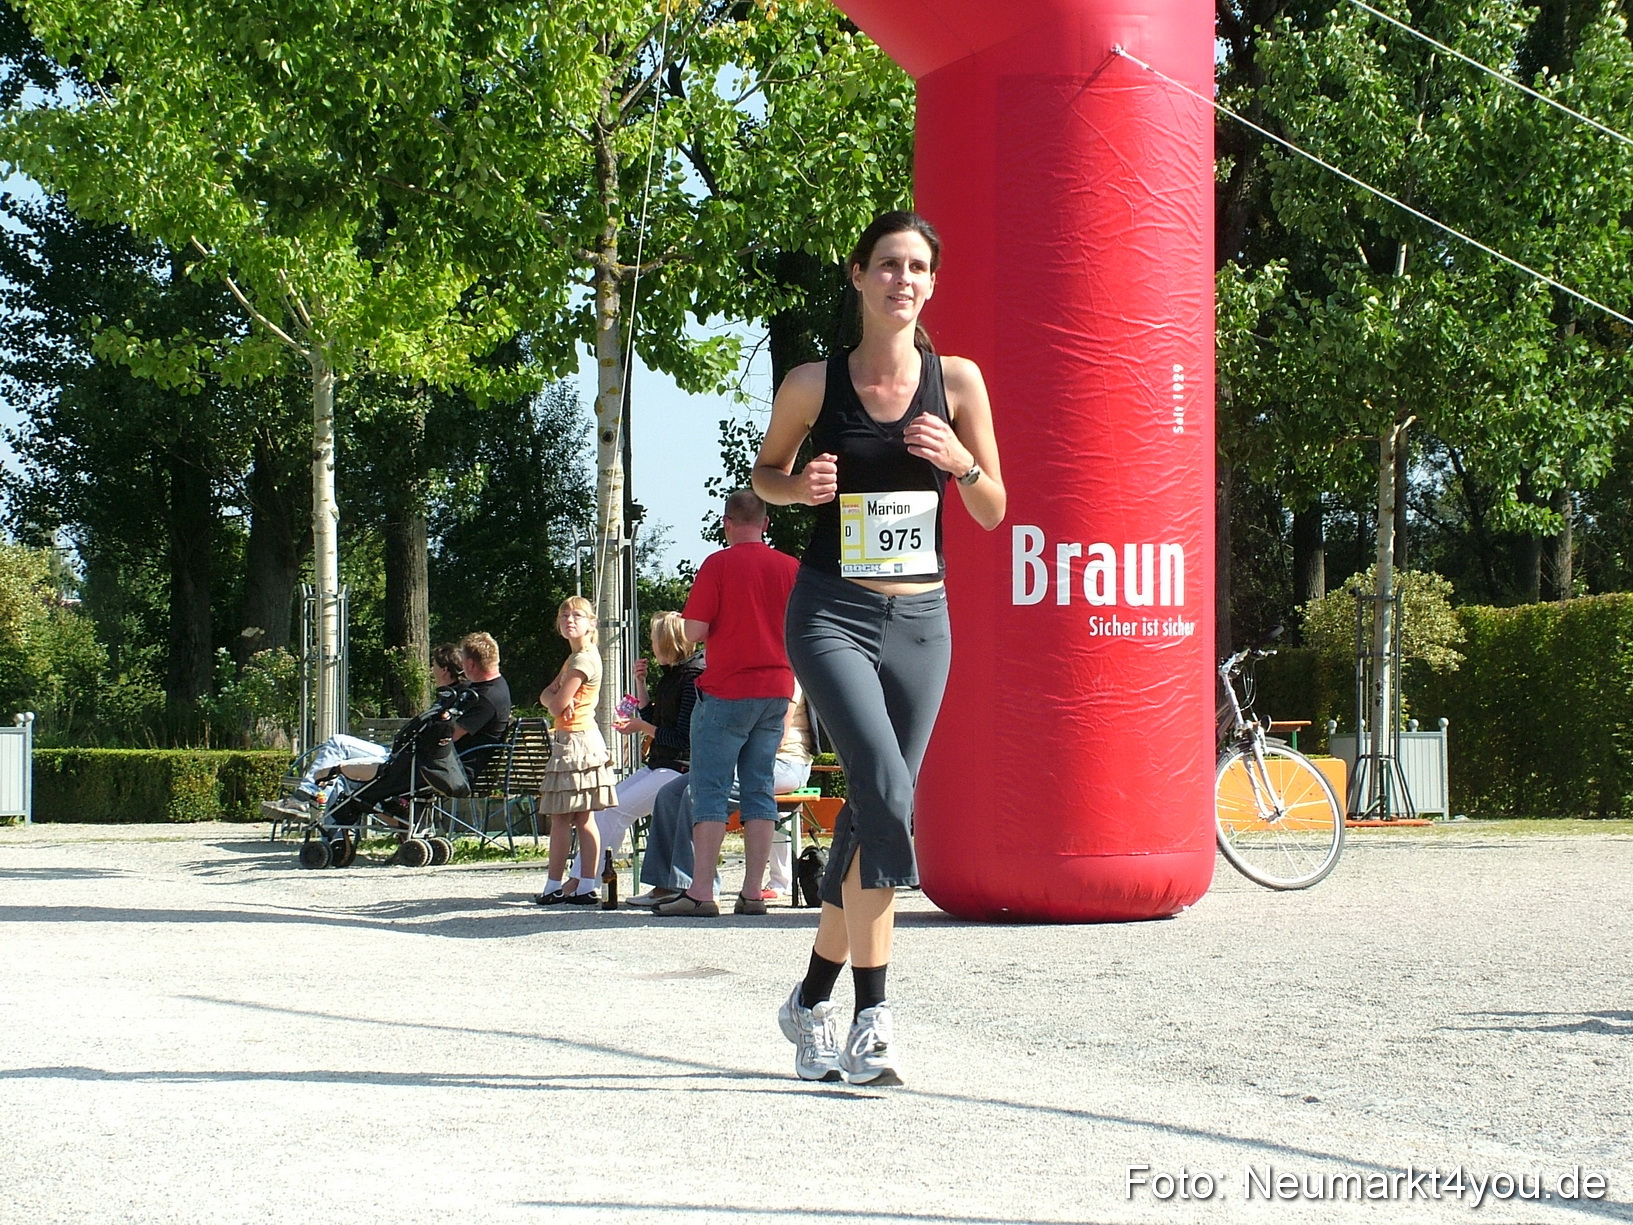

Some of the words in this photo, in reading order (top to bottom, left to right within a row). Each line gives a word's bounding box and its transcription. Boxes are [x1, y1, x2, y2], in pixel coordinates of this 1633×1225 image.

[1172, 364, 1185, 400] 1929
[1172, 406, 1185, 434] Seit
[867, 500, 911, 516] Marion
[845, 526, 852, 537] D
[879, 528, 922, 552] 975
[1012, 525, 1185, 606] Braun
[1089, 614, 1138, 637] Sicher
[1142, 617, 1159, 637] ist
[1162, 614, 1195, 637] sicher
